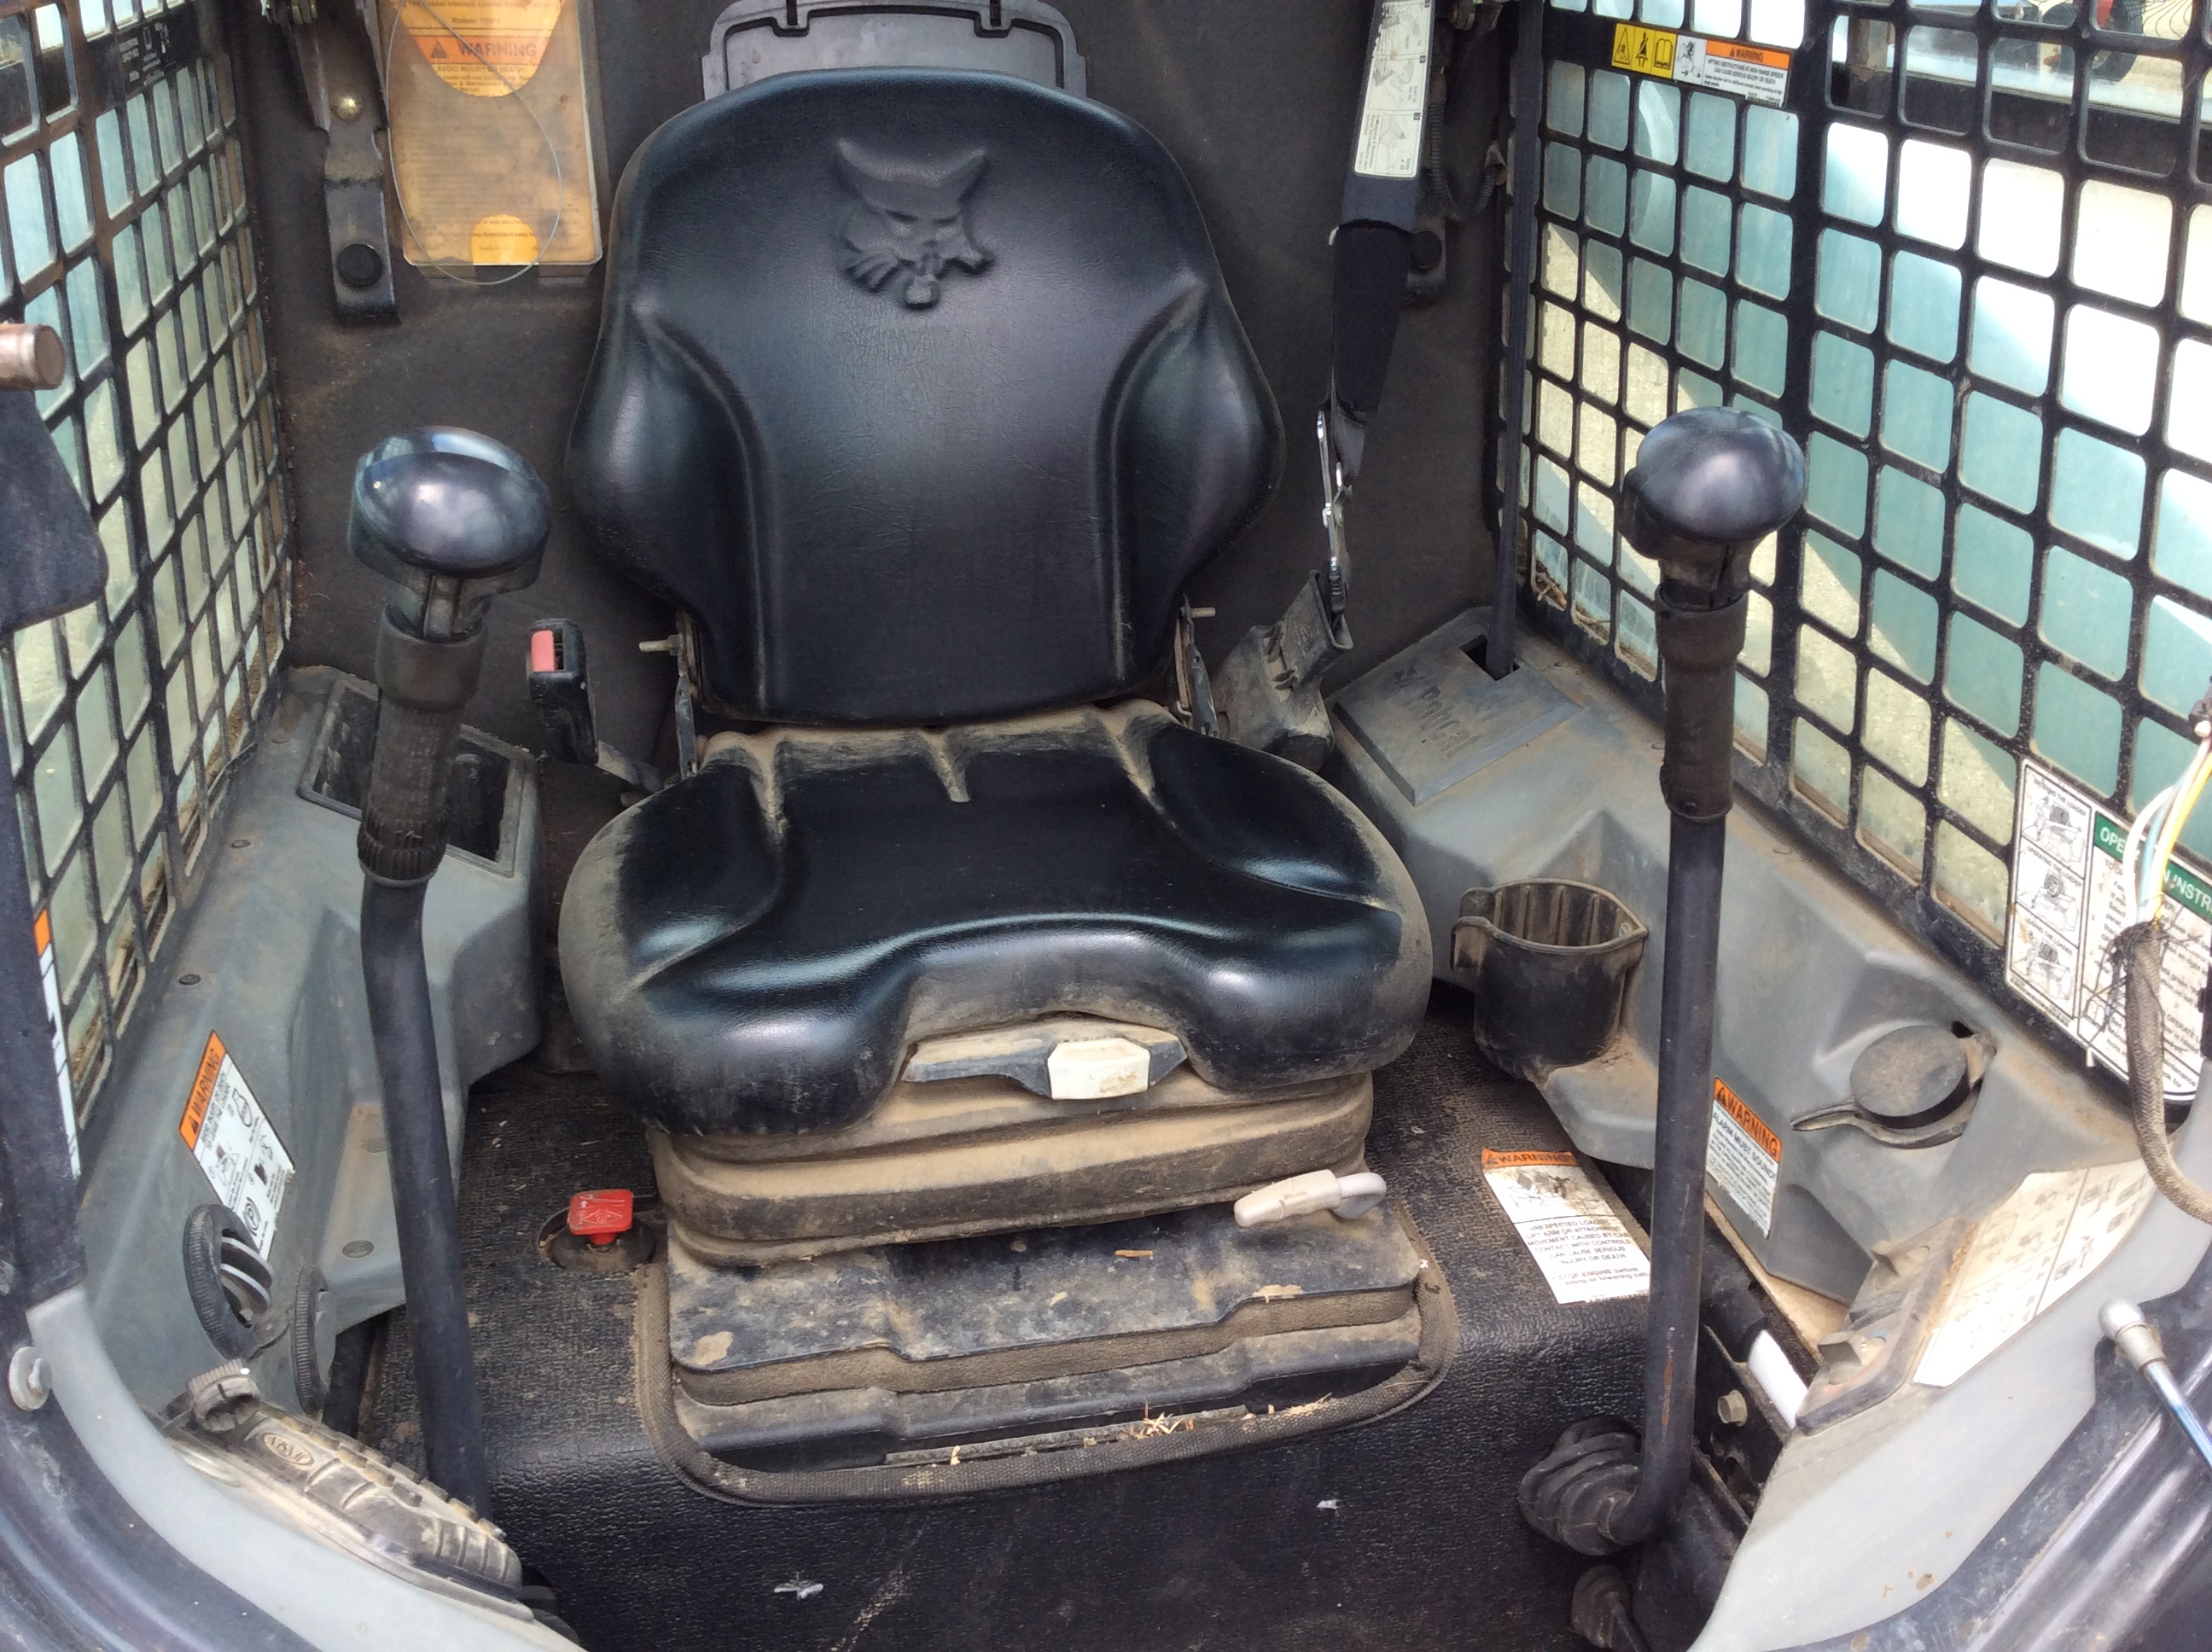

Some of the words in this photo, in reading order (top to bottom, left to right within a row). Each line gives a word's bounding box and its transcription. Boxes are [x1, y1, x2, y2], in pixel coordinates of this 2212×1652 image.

[457, 43, 538, 56] WARNING
[1736, 49, 1764, 62] WARNING
[2066, 800, 2087, 817] LOADER
[2062, 870, 2081, 887] LOADER
[2053, 938, 2073, 955] LOADER
[2167, 1014, 2195, 1038] OPERATE
[191, 1048, 219, 1119] WARNING
[1727, 1093, 1778, 1158] WARNING
[1712, 1112, 1733, 1137] ALARM
[1733, 1132, 1751, 1155] MUST
[1498, 1154, 1571, 1163] WARNING
[1528, 1220, 1578, 1231] UNEXPECTED
[1527, 1236, 1569, 1247] MOVEMENT
[1534, 1245, 1569, 1254] CONTACT
[1581, 1268, 1613, 1277] ENGINE
[1598, 1273, 1633, 1282] lowering
